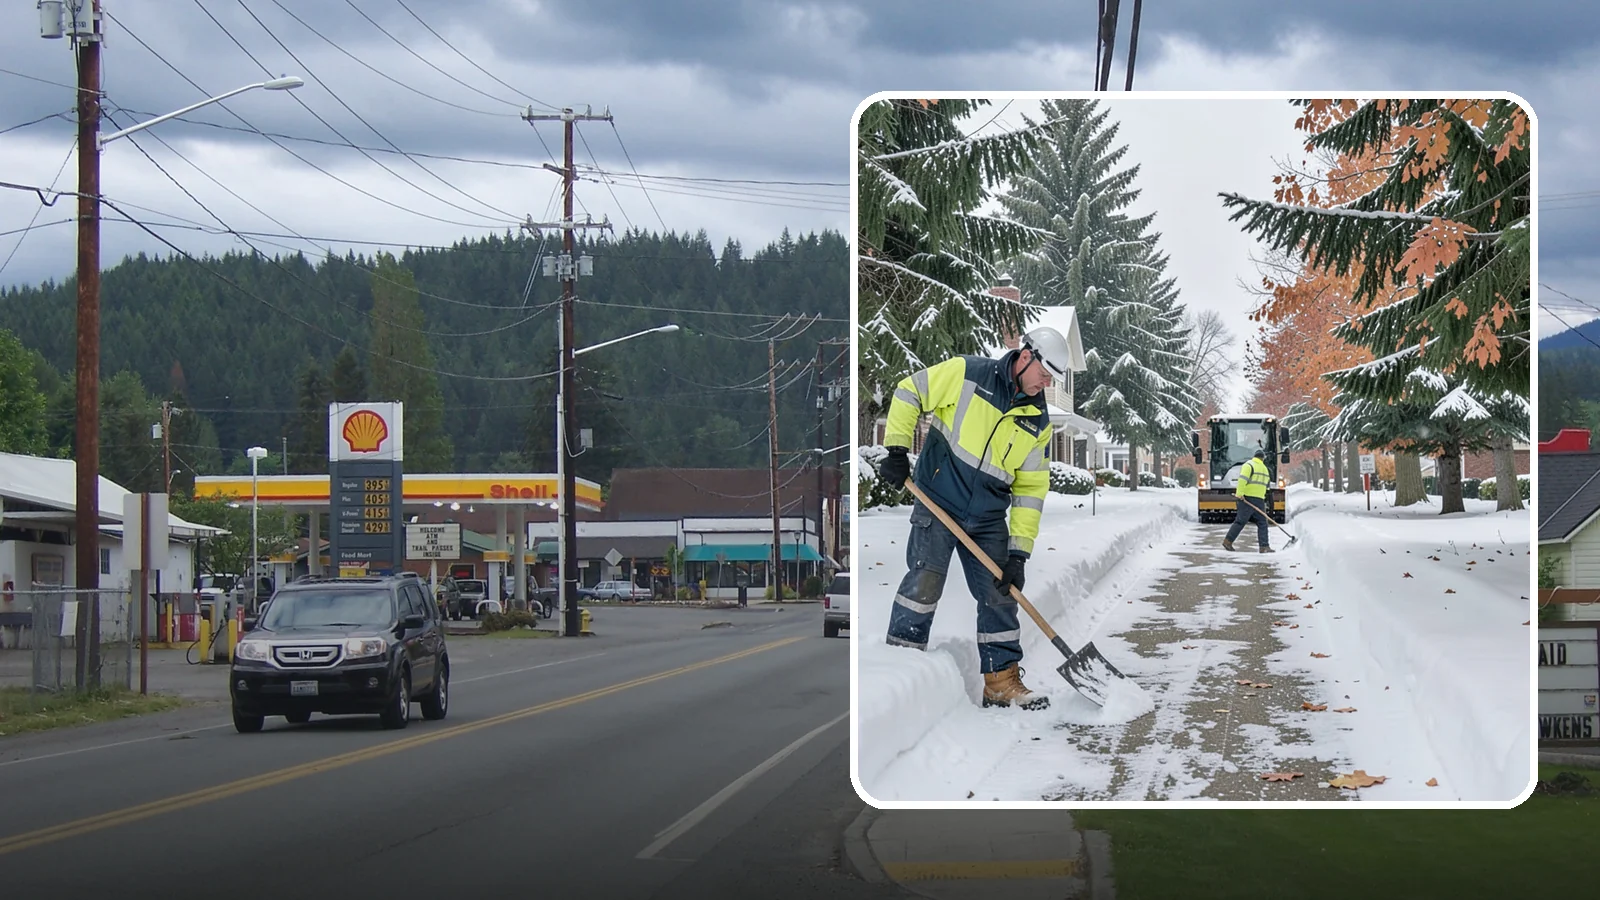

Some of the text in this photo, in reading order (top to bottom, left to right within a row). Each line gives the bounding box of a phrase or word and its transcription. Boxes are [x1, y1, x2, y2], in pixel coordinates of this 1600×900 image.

[365, 480, 384, 490] 395
[490, 484, 547, 499] Shell
[365, 494, 384, 504] 405
[365, 508, 384, 518] 415
[365, 522, 384, 532] 429
